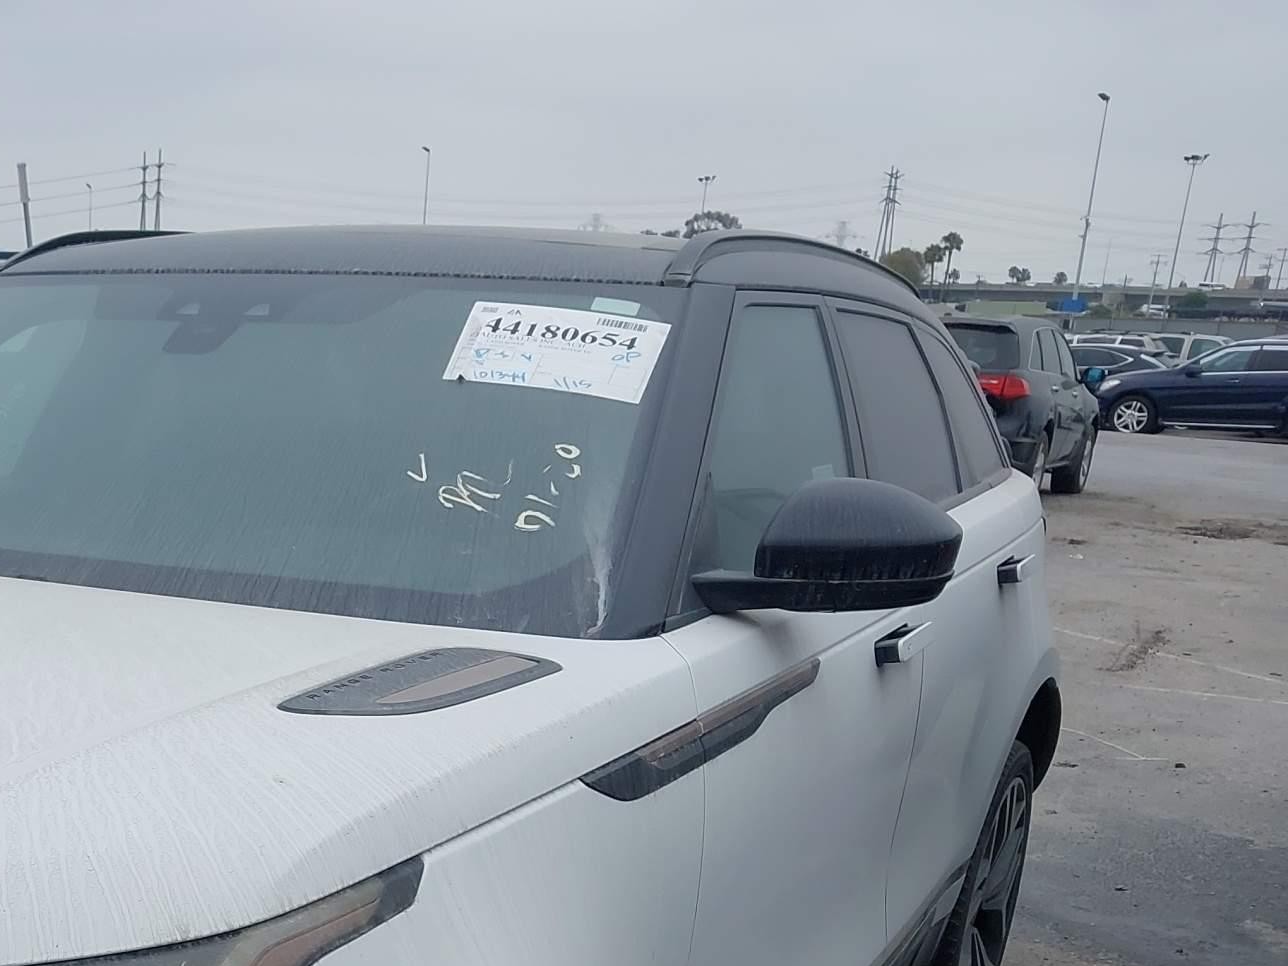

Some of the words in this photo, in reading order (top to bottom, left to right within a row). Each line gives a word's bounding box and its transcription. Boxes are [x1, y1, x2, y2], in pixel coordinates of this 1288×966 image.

[485, 316, 639, 351] 44180654
[305, 674, 374, 701] RANGE
[379, 651, 444, 674] ROVER
